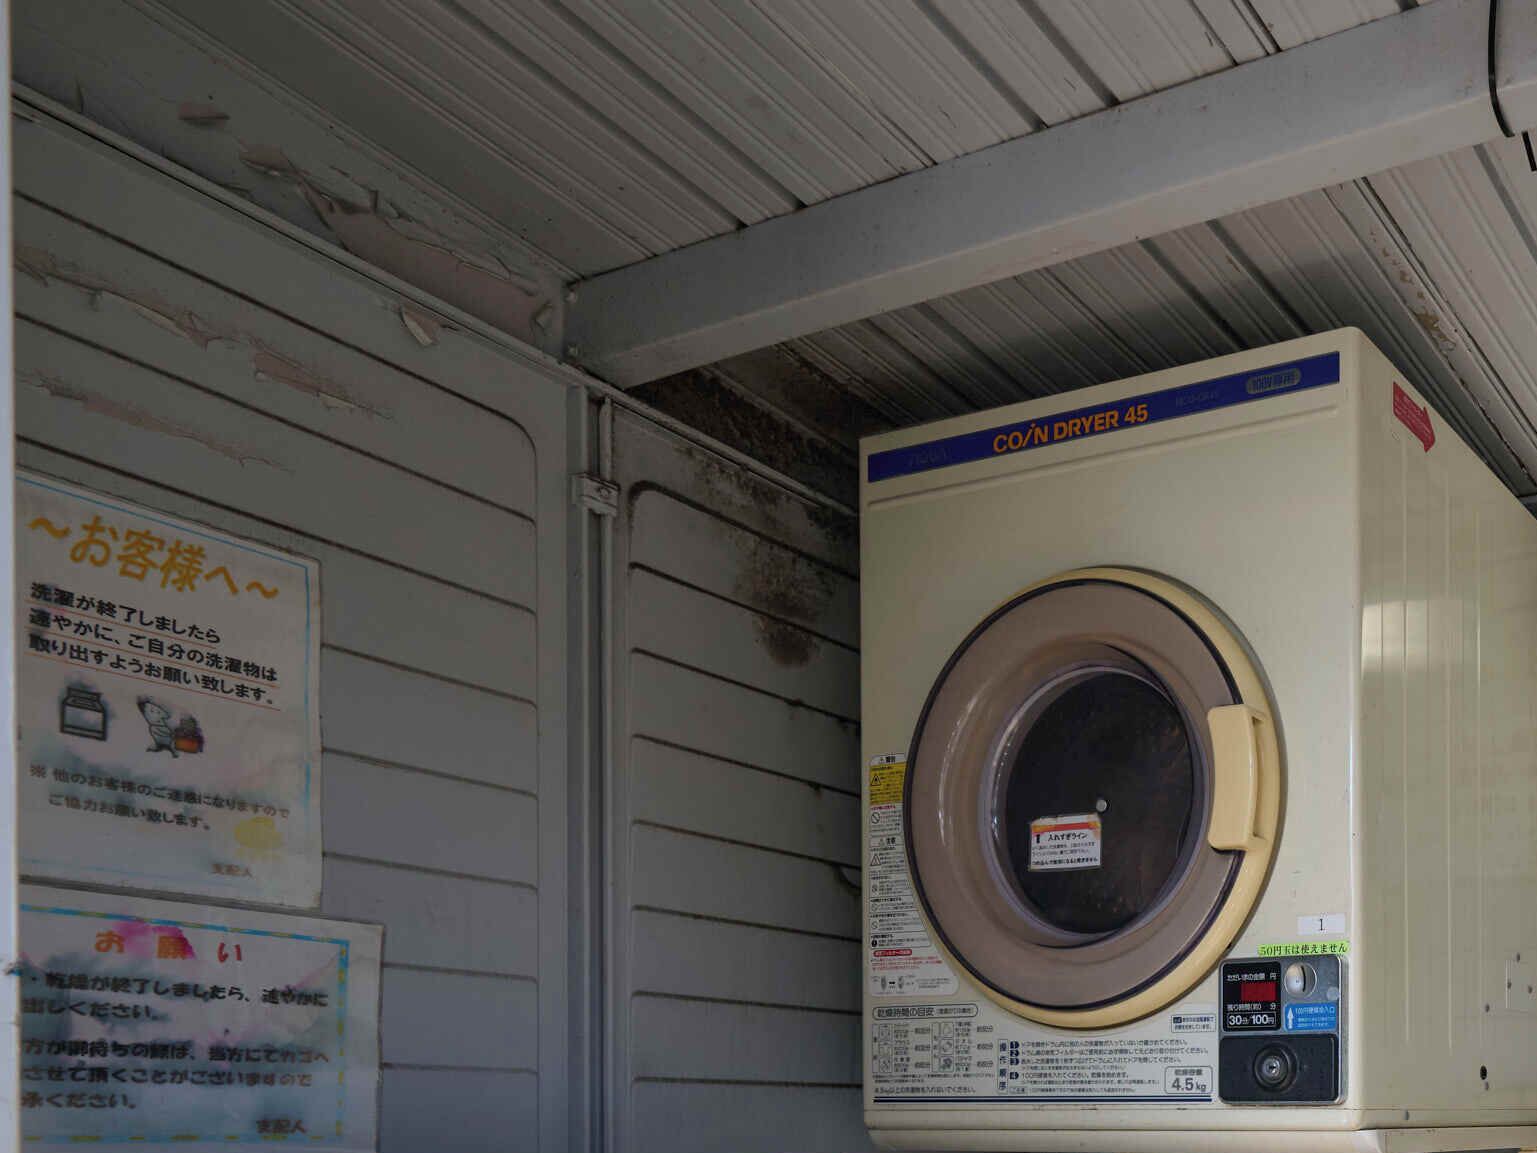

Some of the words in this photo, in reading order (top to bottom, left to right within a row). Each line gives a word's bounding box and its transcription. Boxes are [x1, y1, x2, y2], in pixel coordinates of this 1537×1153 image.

[993, 422, 1050, 455] COIN
[1053, 410, 1119, 444] DRYER
[1124, 403, 1149, 428] 45
[28, 607, 279, 684] 速やかに、ご自分の洗濯物は
[29, 582, 221, 645] 洗濯が終了しましたら
[28, 634, 276, 706] 取り出すようお願い致します。
